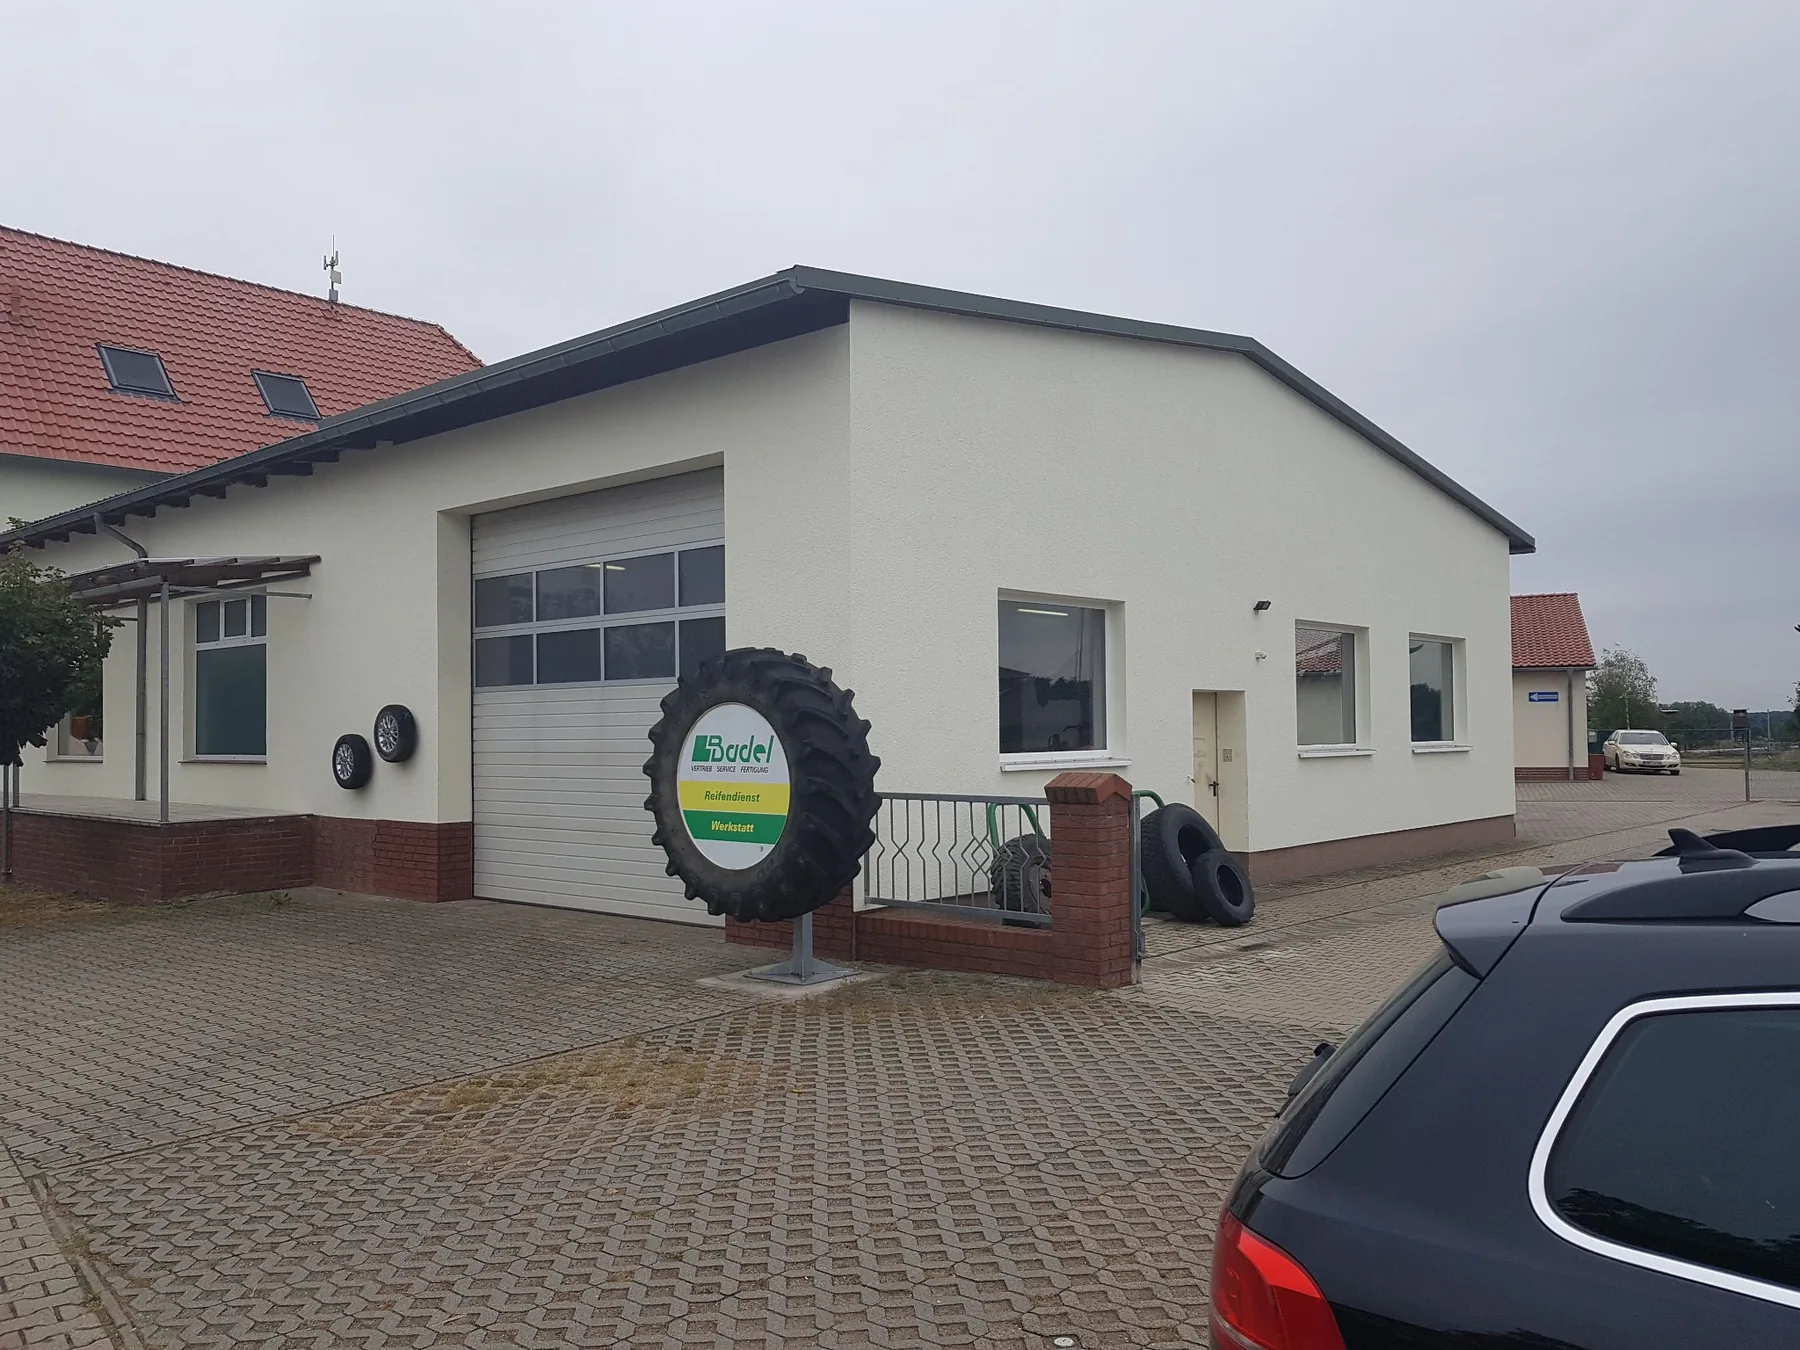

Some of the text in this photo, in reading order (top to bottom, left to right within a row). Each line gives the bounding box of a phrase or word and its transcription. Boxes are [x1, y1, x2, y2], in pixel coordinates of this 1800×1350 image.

[707, 735, 775, 763] Badel
[740, 766, 769, 774] FERTIGUNG
[704, 790, 761, 802] Reifendienst
[711, 820, 754, 833] Werkstatt
